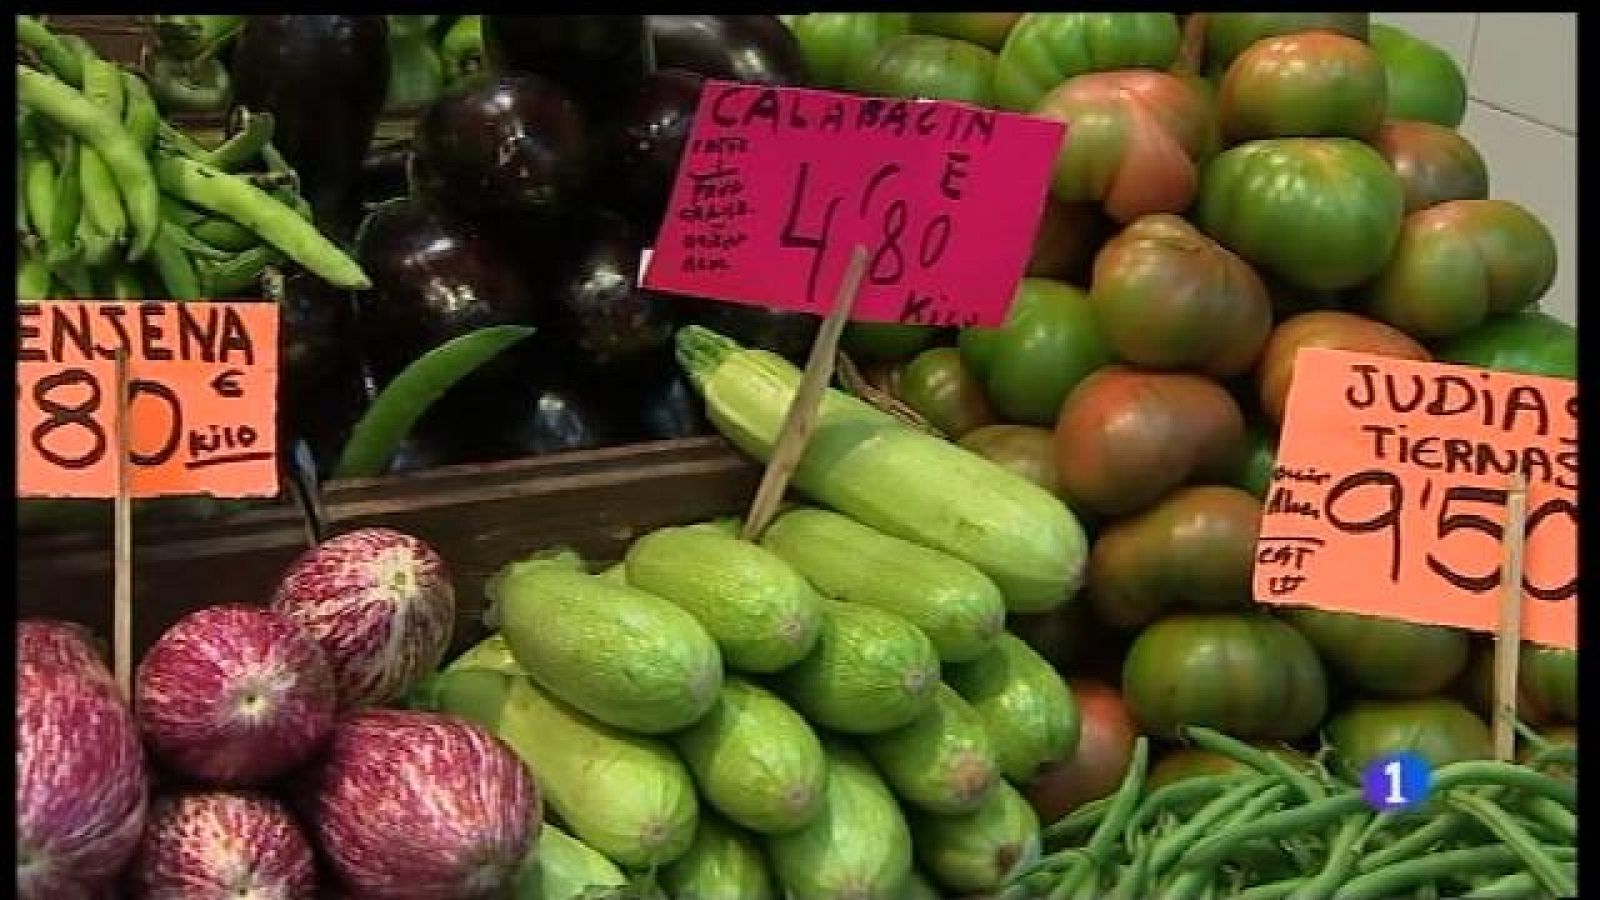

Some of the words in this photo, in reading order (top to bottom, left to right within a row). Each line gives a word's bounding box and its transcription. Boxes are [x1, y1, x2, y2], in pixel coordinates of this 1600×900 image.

[712, 88, 995, 143] CALABACIN
[18, 304, 255, 366] ENJENA
[210, 369, 247, 398] €
[1324, 470, 1578, 602] 9'50
